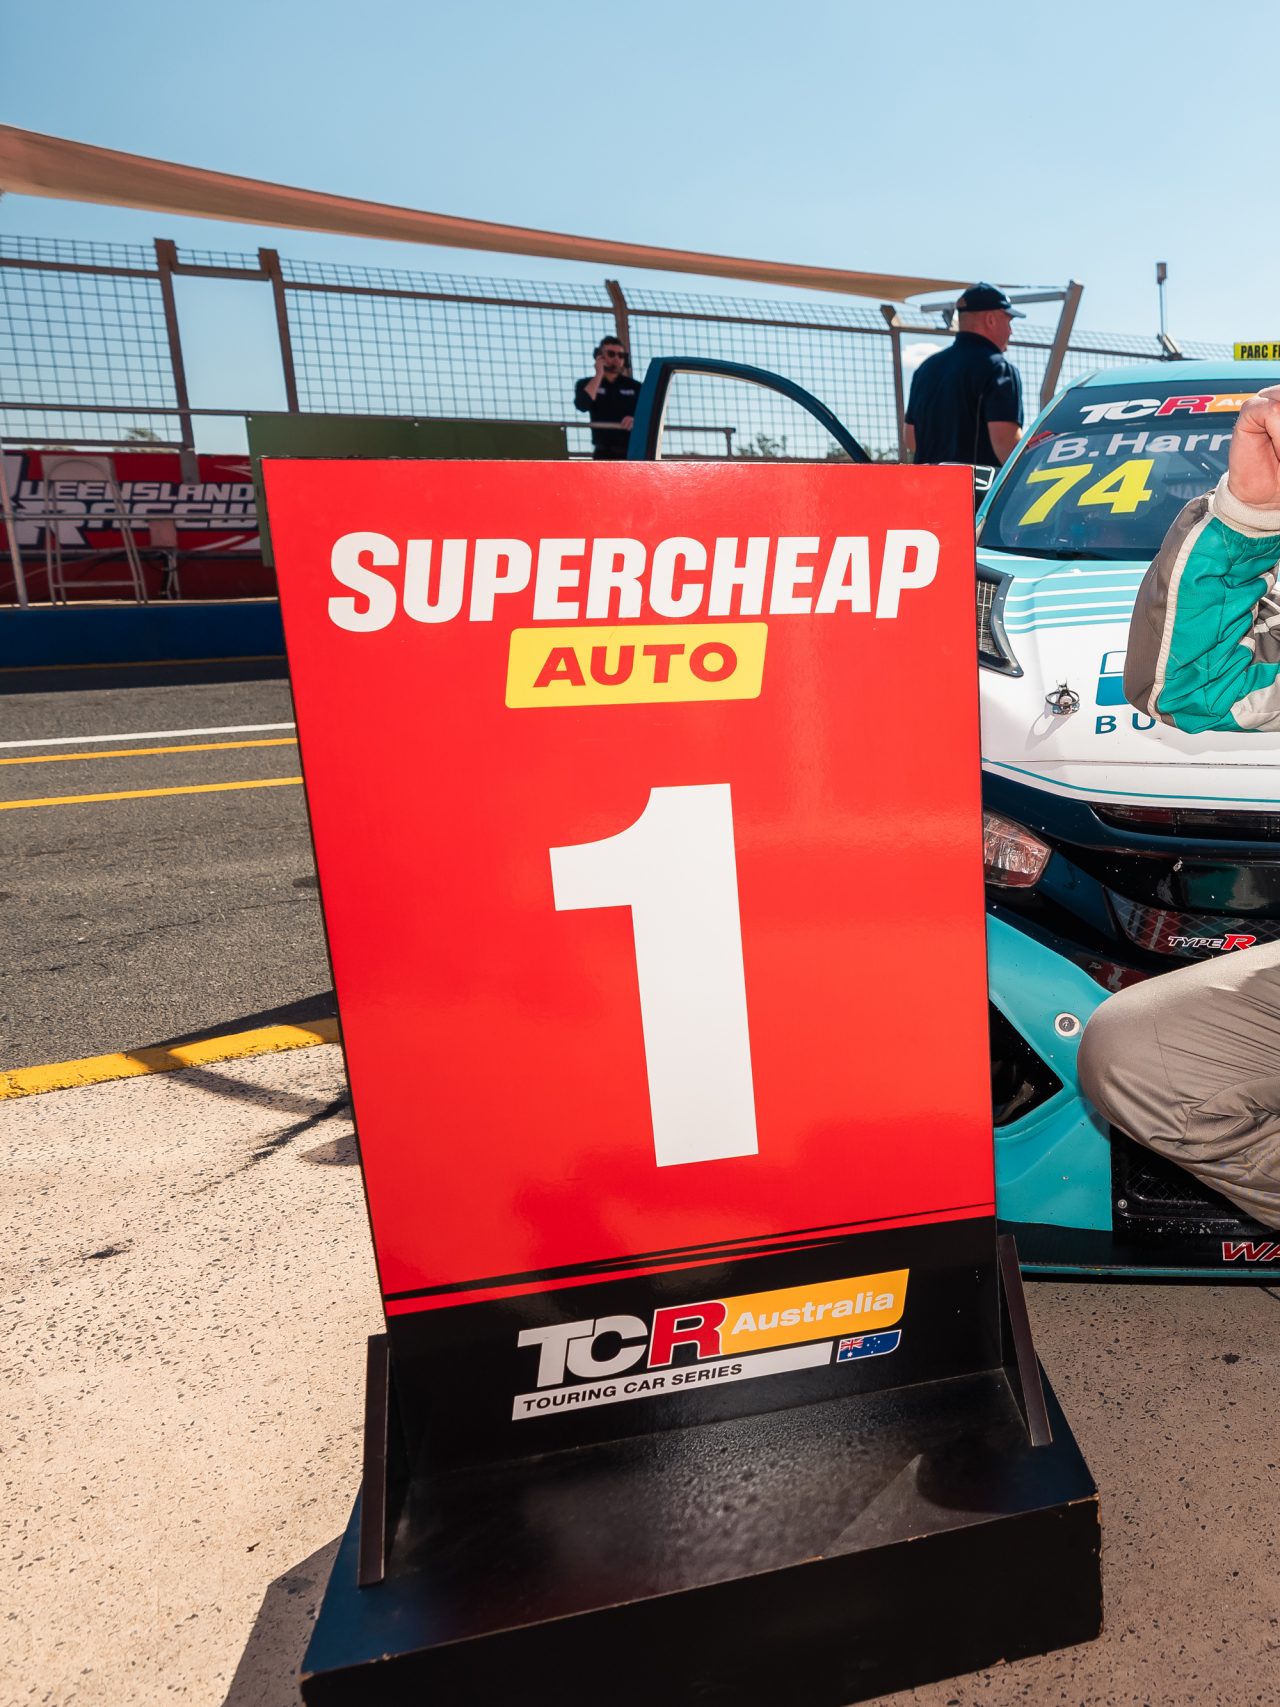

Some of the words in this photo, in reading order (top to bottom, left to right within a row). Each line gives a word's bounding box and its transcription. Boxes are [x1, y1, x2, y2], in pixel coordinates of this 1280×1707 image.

[1240, 345, 1268, 358] PARC
[1080, 394, 1216, 424] TCR
[1018, 458, 1155, 526] 74
[328, 529, 941, 632] SUPERCHEAP
[532, 642, 738, 688] AUTO
[1168, 936, 1223, 948] TYPE
[549, 783, 759, 1168] 1
[517, 1300, 727, 1388] TCR
[731, 1290, 894, 1335] Australia
[523, 1384, 617, 1412] TOURING
[624, 1377, 665, 1394] CAR
[671, 1364, 743, 1386] SERIES
